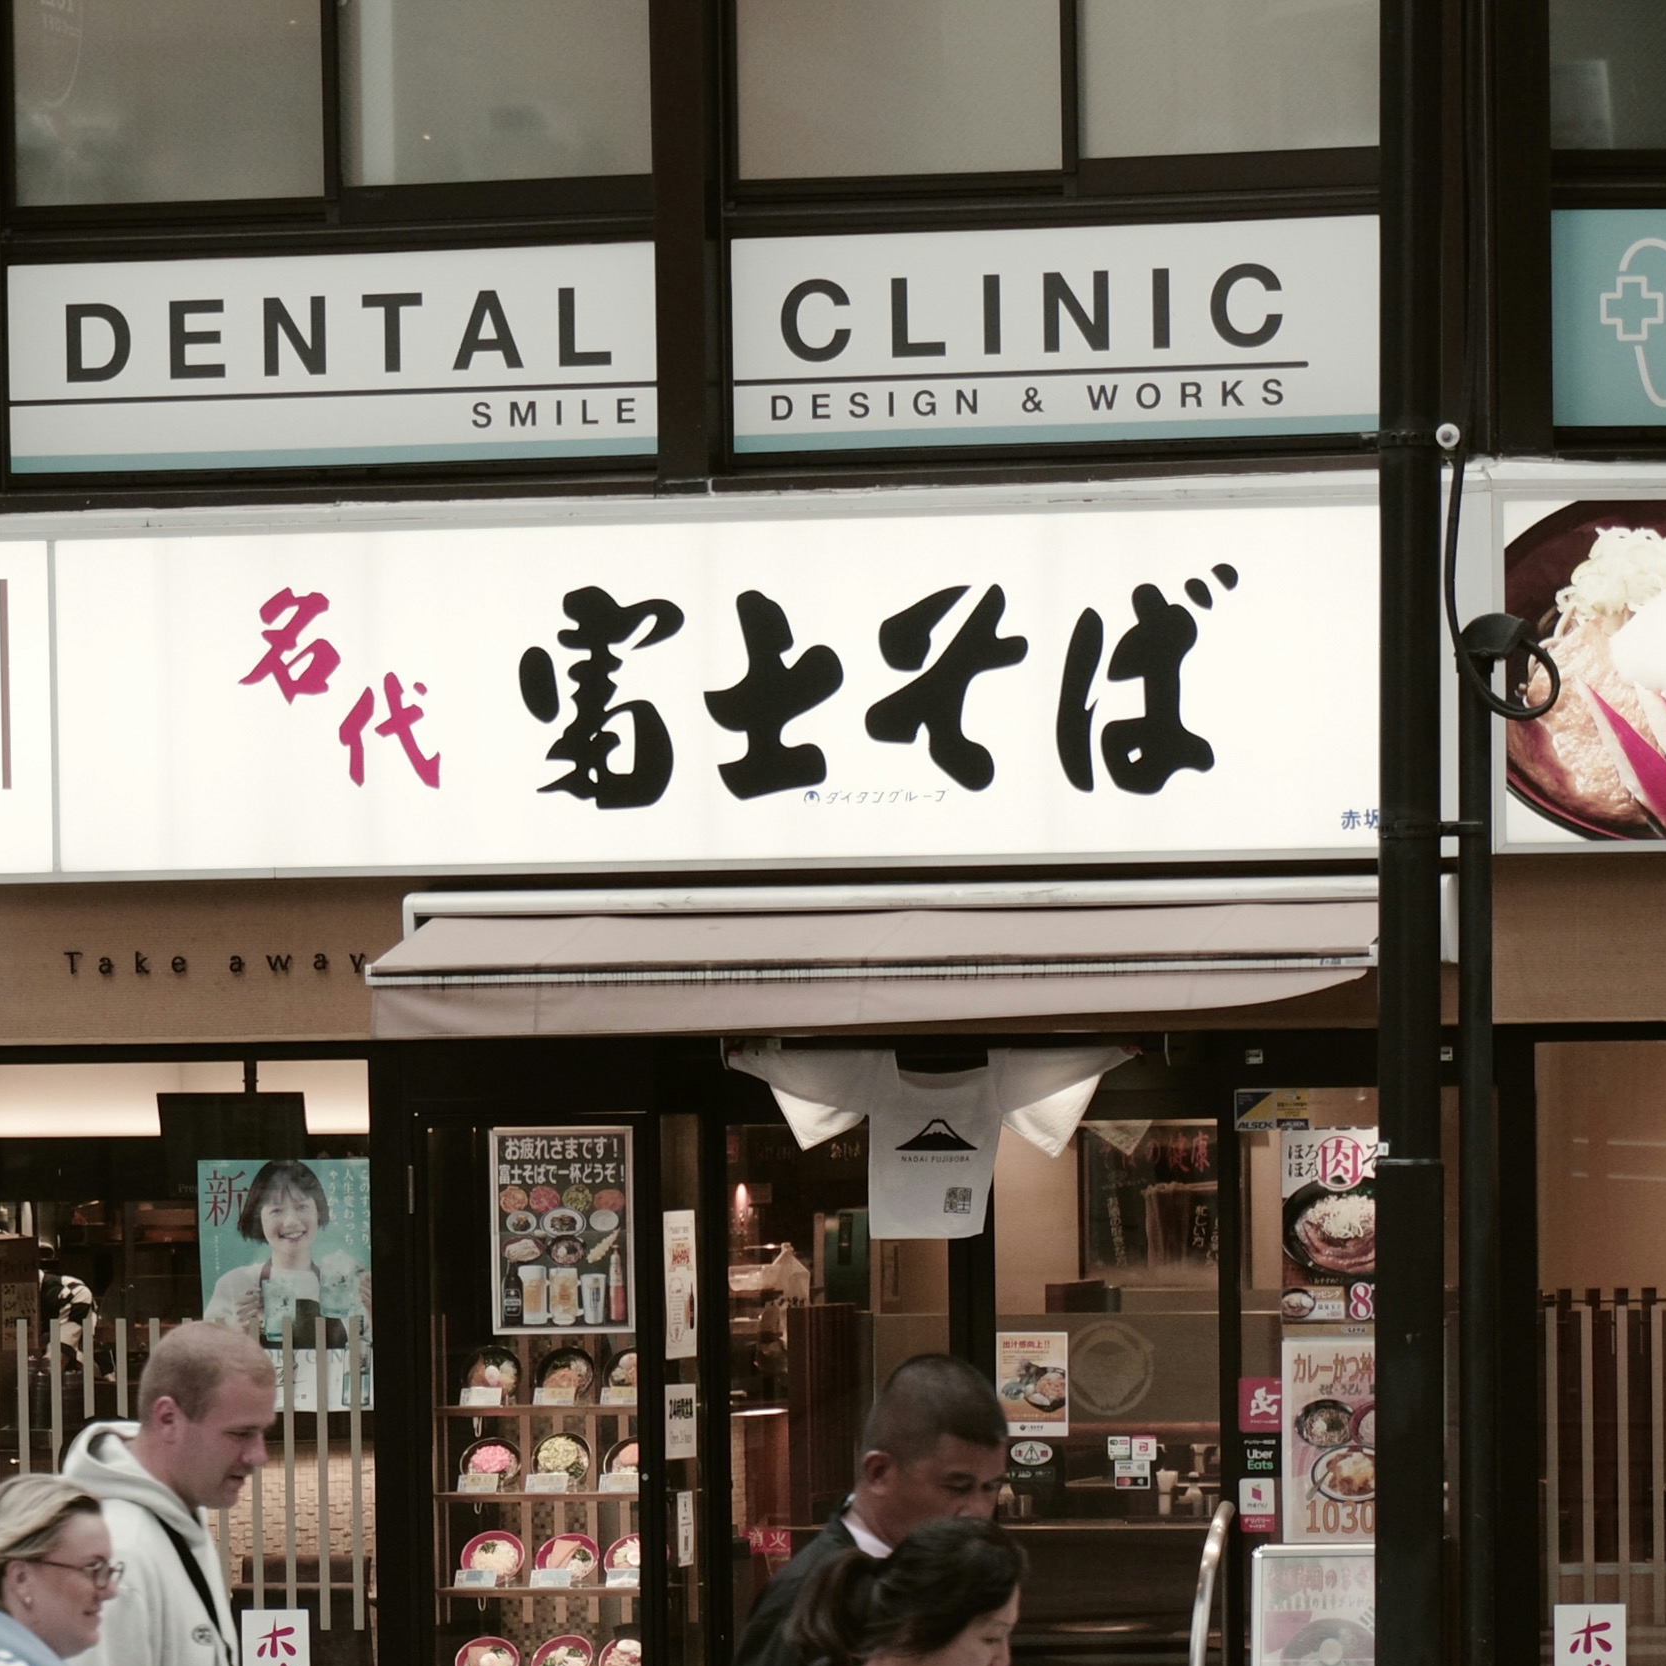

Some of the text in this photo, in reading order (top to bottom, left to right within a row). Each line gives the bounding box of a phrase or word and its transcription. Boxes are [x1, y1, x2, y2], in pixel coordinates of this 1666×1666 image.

[65, 287, 612, 383] DENTAL
[779, 262, 1284, 363] CLINIC
[470, 378, 1285, 429] SMILE DESIGN & WORKS
[239, 562, 1239, 809] 名代 富士そば
[825, 788, 949, 805] ダイタングループ
[64, 951, 366, 975] Take away
[1238, 1121, 1273, 1129] ALSOK
[505, 1136, 619, 1161] お疲れさまです！
[931, 1155, 970, 1163] FUJISOBA
[499, 1162, 624, 1185] 富士そばで一杯どうぞ！
[1288, 1144, 1318, 1161] ほろ
[1321, 1138, 1360, 1186] 肉
[1288, 1162, 1318, 1178] ほろ
[204, 1169, 250, 1227] 新
[306, 1349, 343, 1364] GN
[1247, 1448, 1274, 1460] Uber
[1247, 1460, 1274, 1471] Eats
